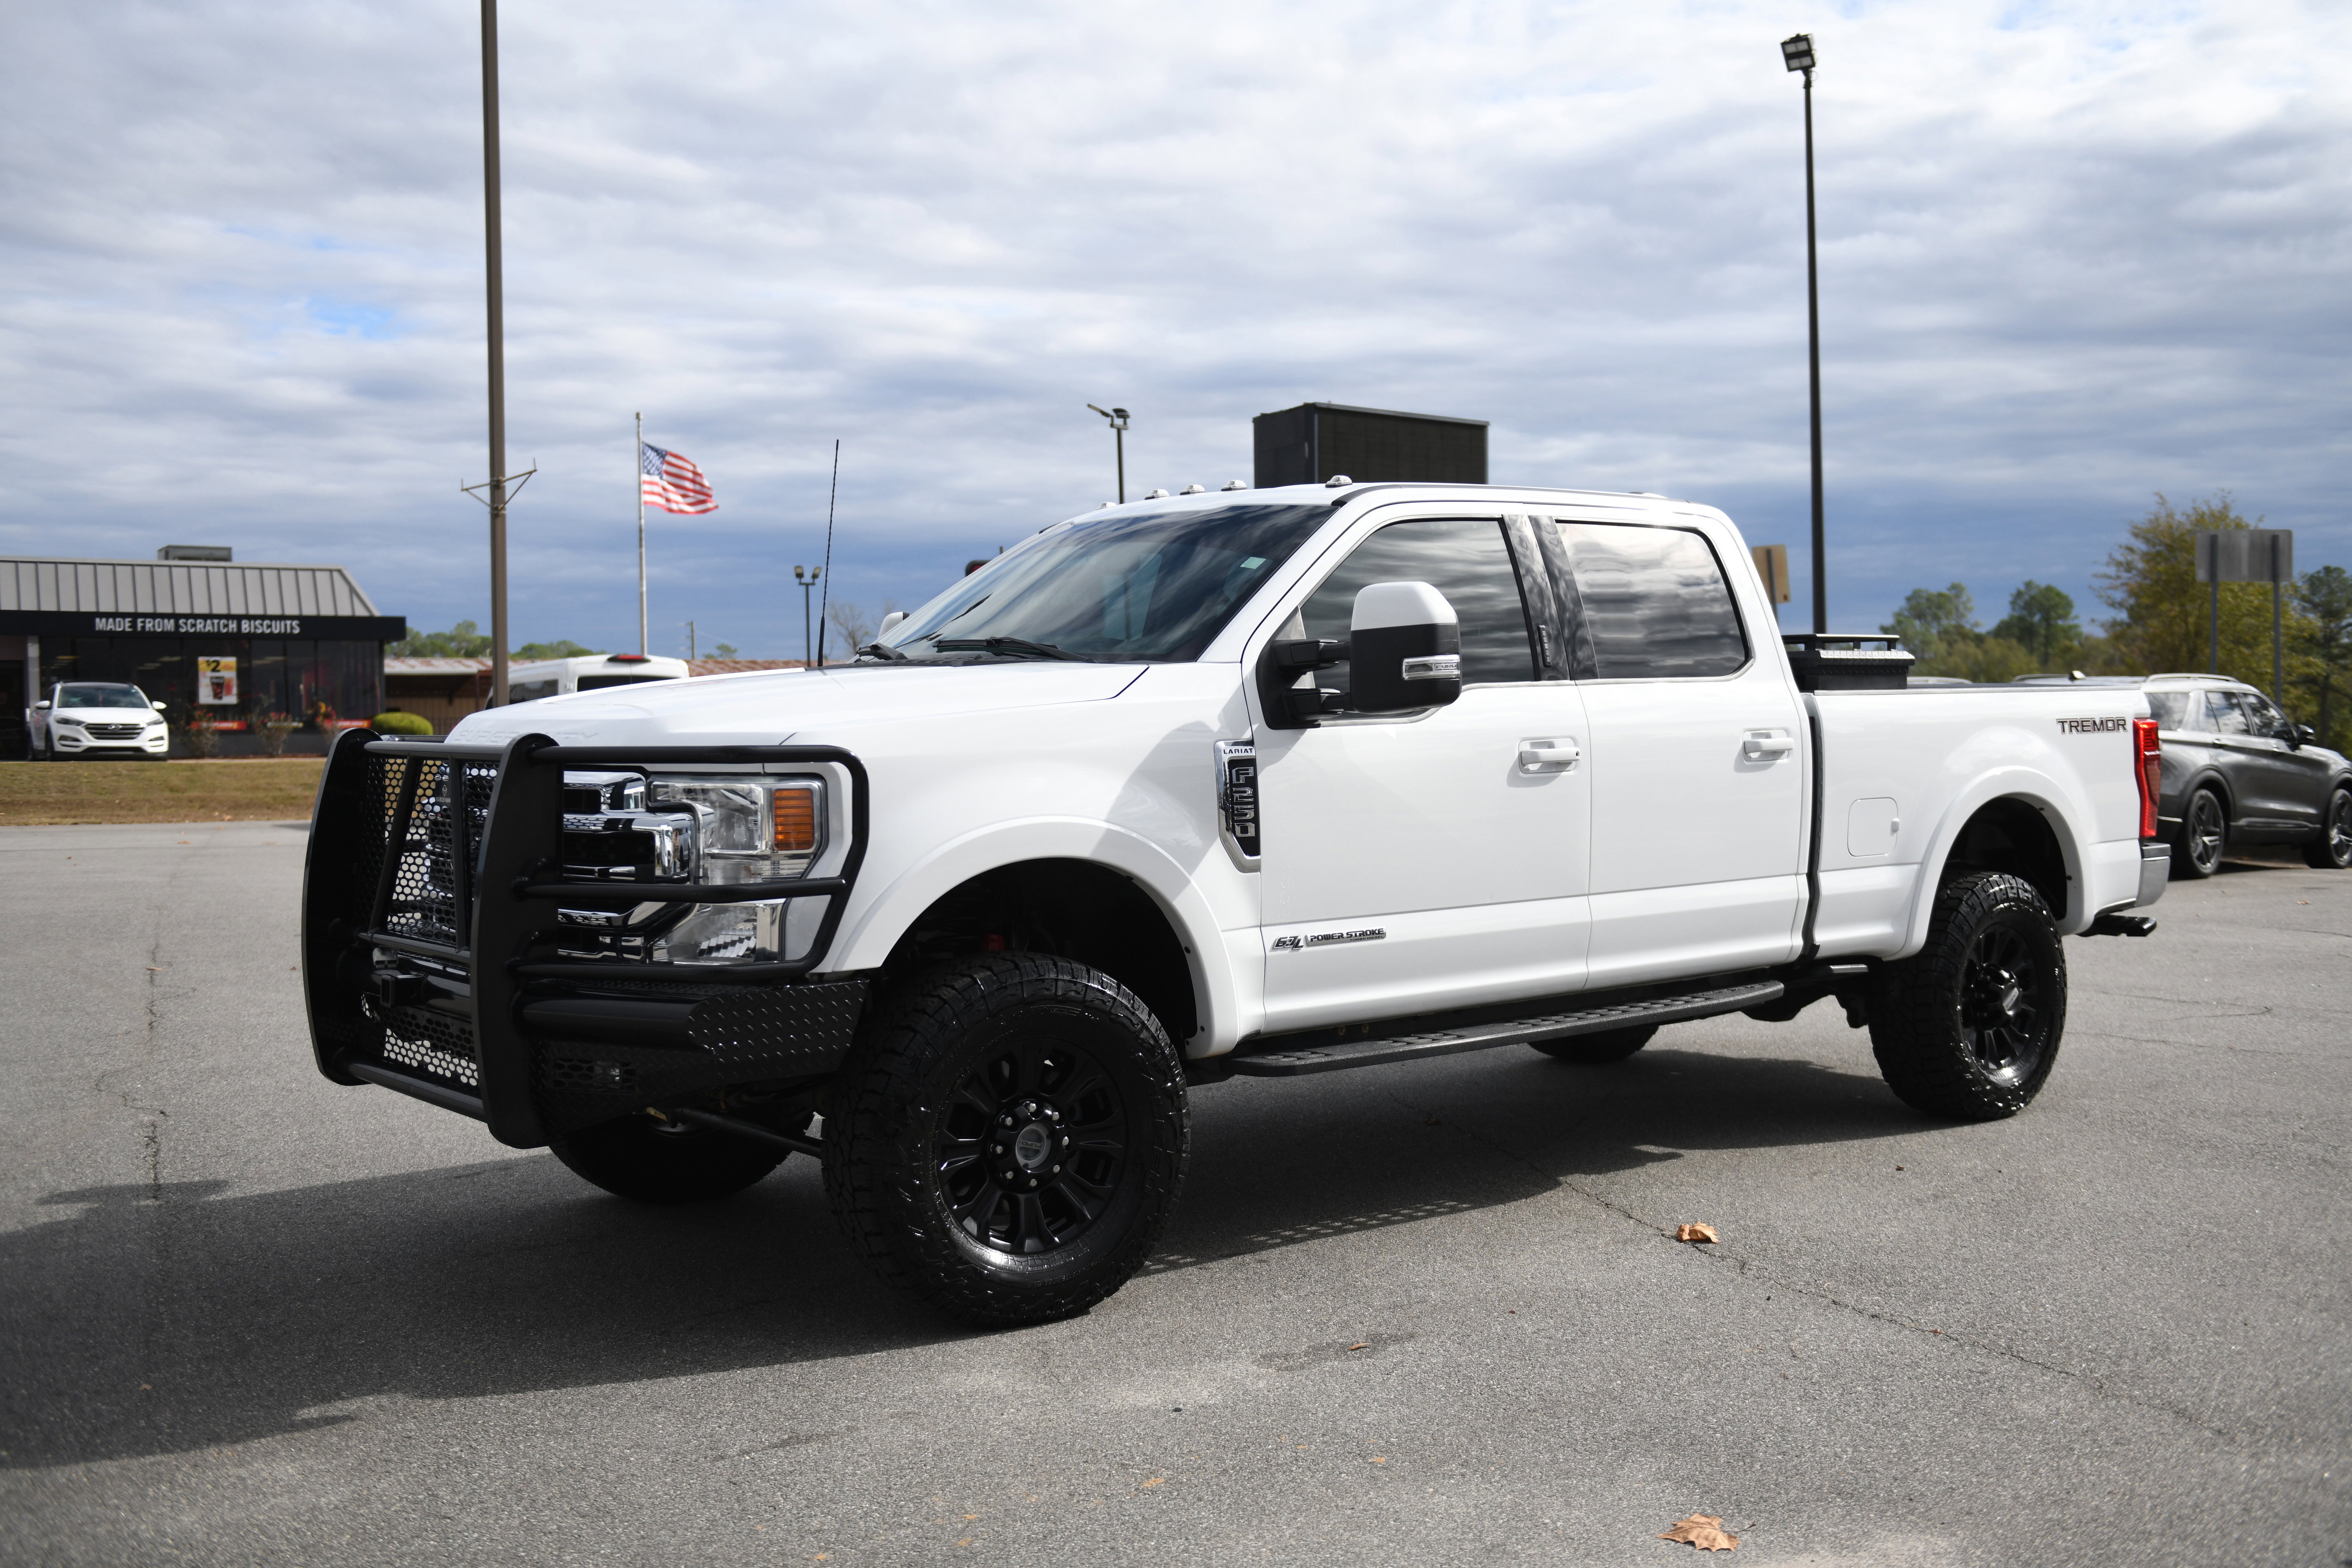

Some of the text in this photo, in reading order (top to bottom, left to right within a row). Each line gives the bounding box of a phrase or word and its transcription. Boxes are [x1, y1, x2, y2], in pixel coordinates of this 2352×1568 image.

[95, 617, 300, 634] MADE FROM SCRATCH BISCUITS
[2056, 717, 2128, 735] TREMOR
[1310, 933, 1344, 942] POWER
[1346, 928, 1384, 938] STROKE
